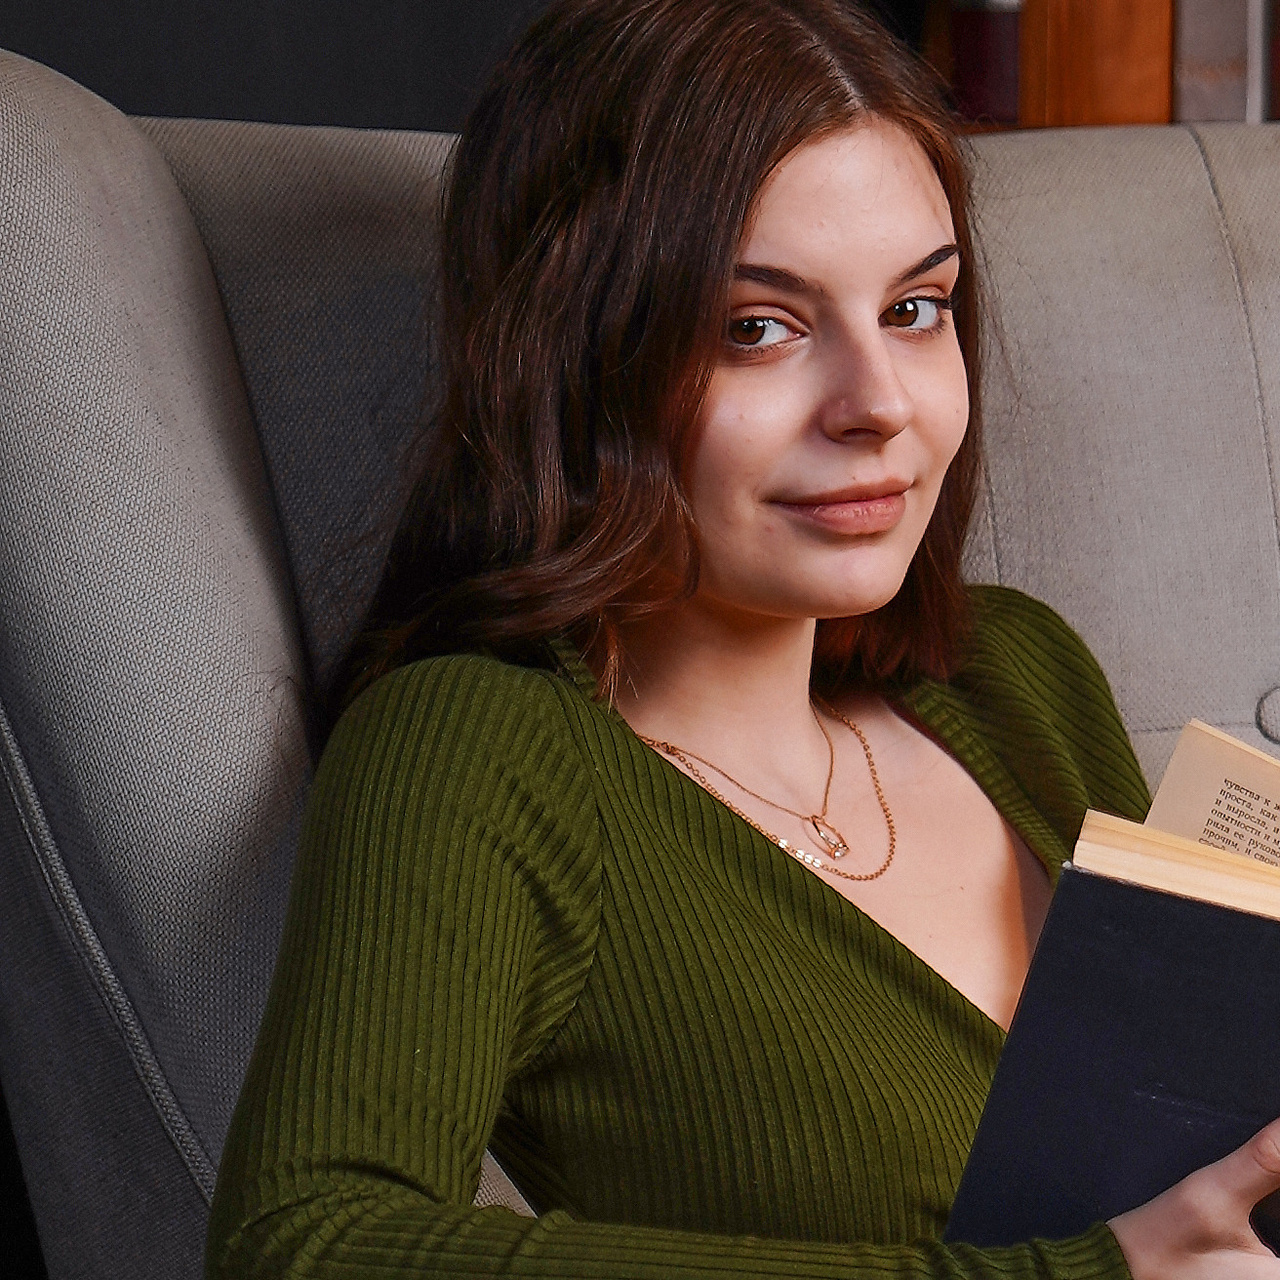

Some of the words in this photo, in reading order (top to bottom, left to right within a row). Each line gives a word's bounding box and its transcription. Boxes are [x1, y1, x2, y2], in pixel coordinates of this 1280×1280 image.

[1224, 778, 1260, 801] чувства
[1219, 788, 1254, 811] проста,
[1260, 808, 1278, 822] как
[1226, 803, 1268, 830] выросла,
[1206, 818, 1230, 834] рила
[1210, 808, 1262, 838] опытности
[1202, 828, 1240, 852] прочим,
